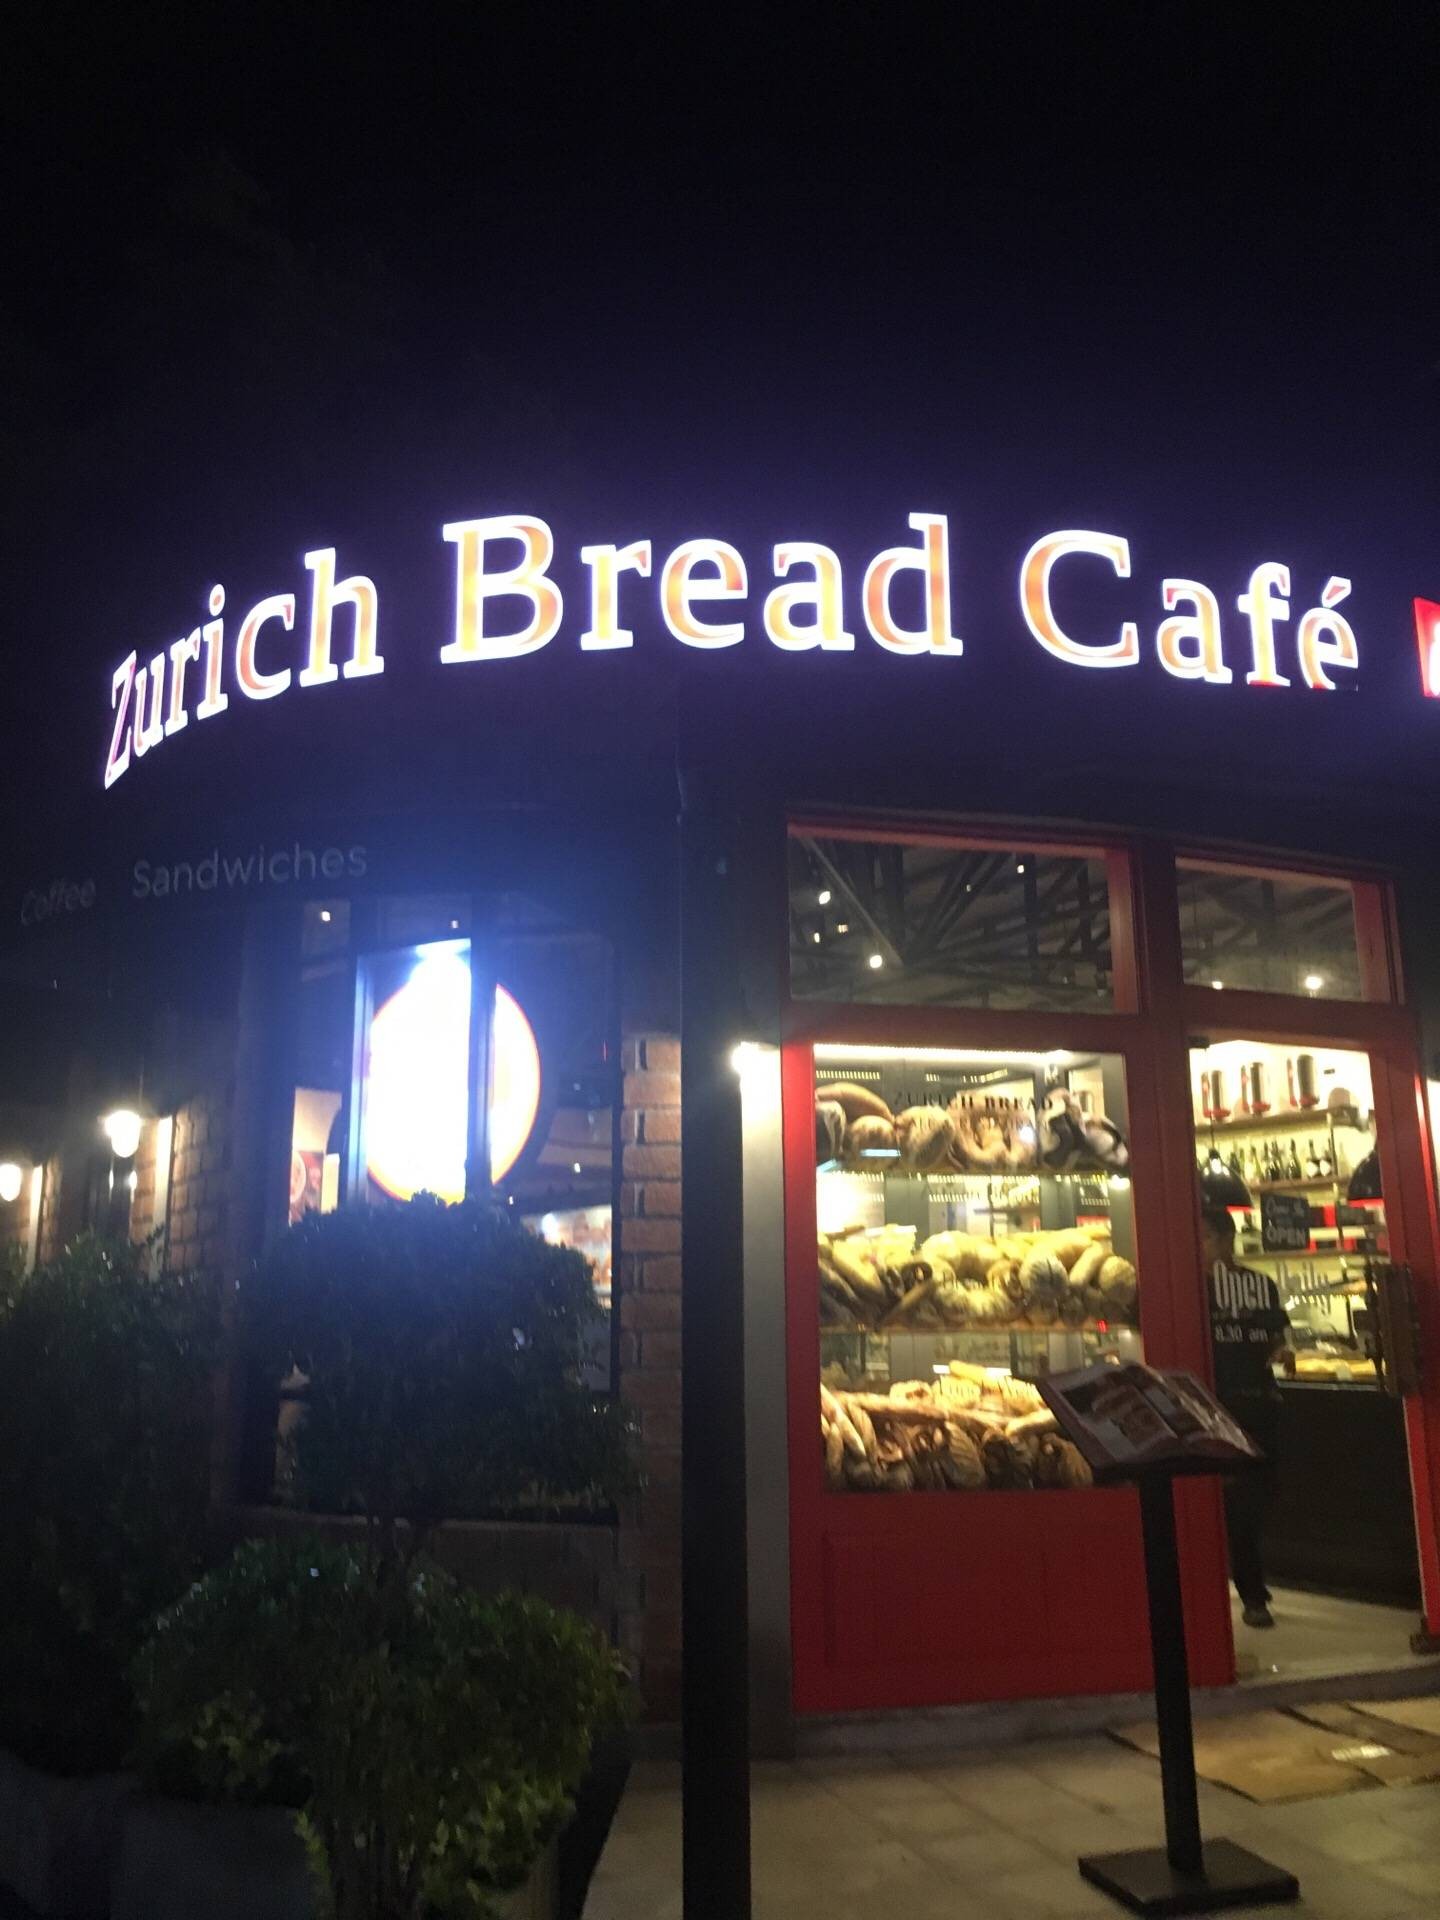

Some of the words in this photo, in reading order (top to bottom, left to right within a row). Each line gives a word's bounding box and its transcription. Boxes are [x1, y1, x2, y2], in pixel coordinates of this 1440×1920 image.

[104, 546, 385, 790] Zurich
[440, 513, 965, 666] Bread
[1019, 529, 1359, 692] Café
[132, 842, 368, 899] Sandwiches
[893, 1091, 974, 1110] ZURICH
[984, 1094, 1055, 1112] BREAD
[1213, 1259, 1270, 1320] Open
